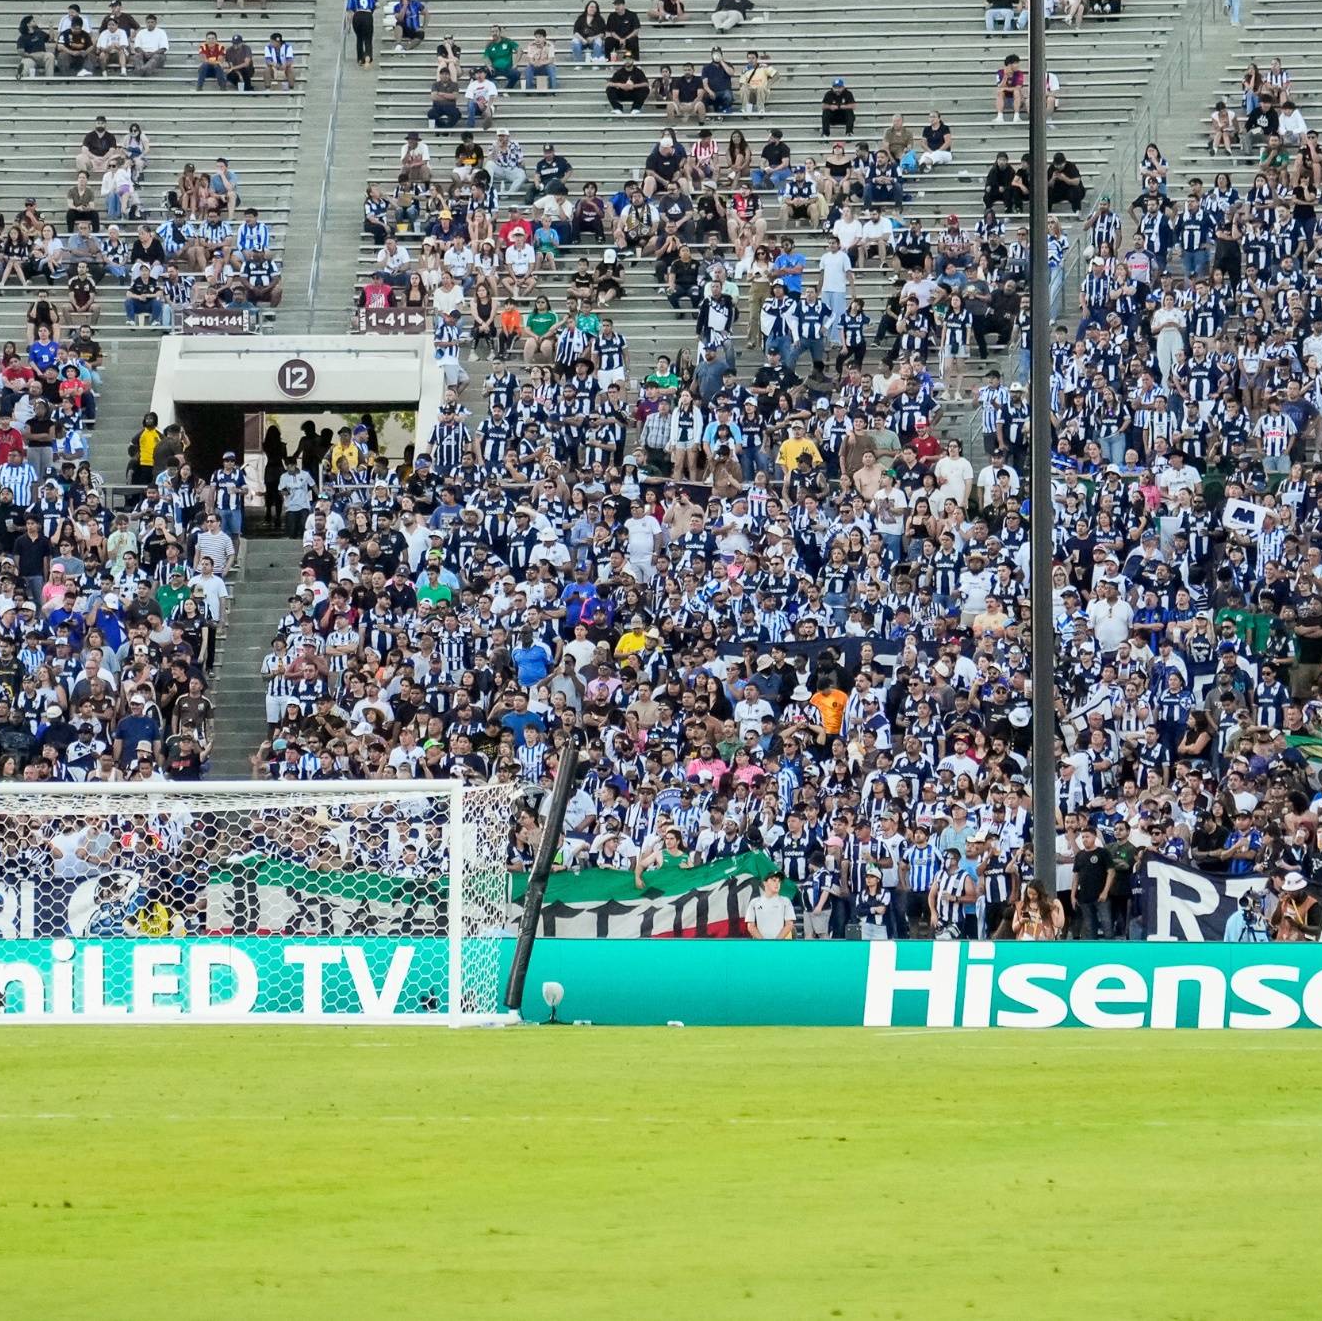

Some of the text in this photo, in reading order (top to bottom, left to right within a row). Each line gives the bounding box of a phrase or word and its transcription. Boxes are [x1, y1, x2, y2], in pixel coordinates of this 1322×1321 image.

[200, 315, 243, 327] 101-141
[368, 312, 406, 327] 1-41
[285, 367, 308, 389] 12
[284, 945, 415, 1015] TV
